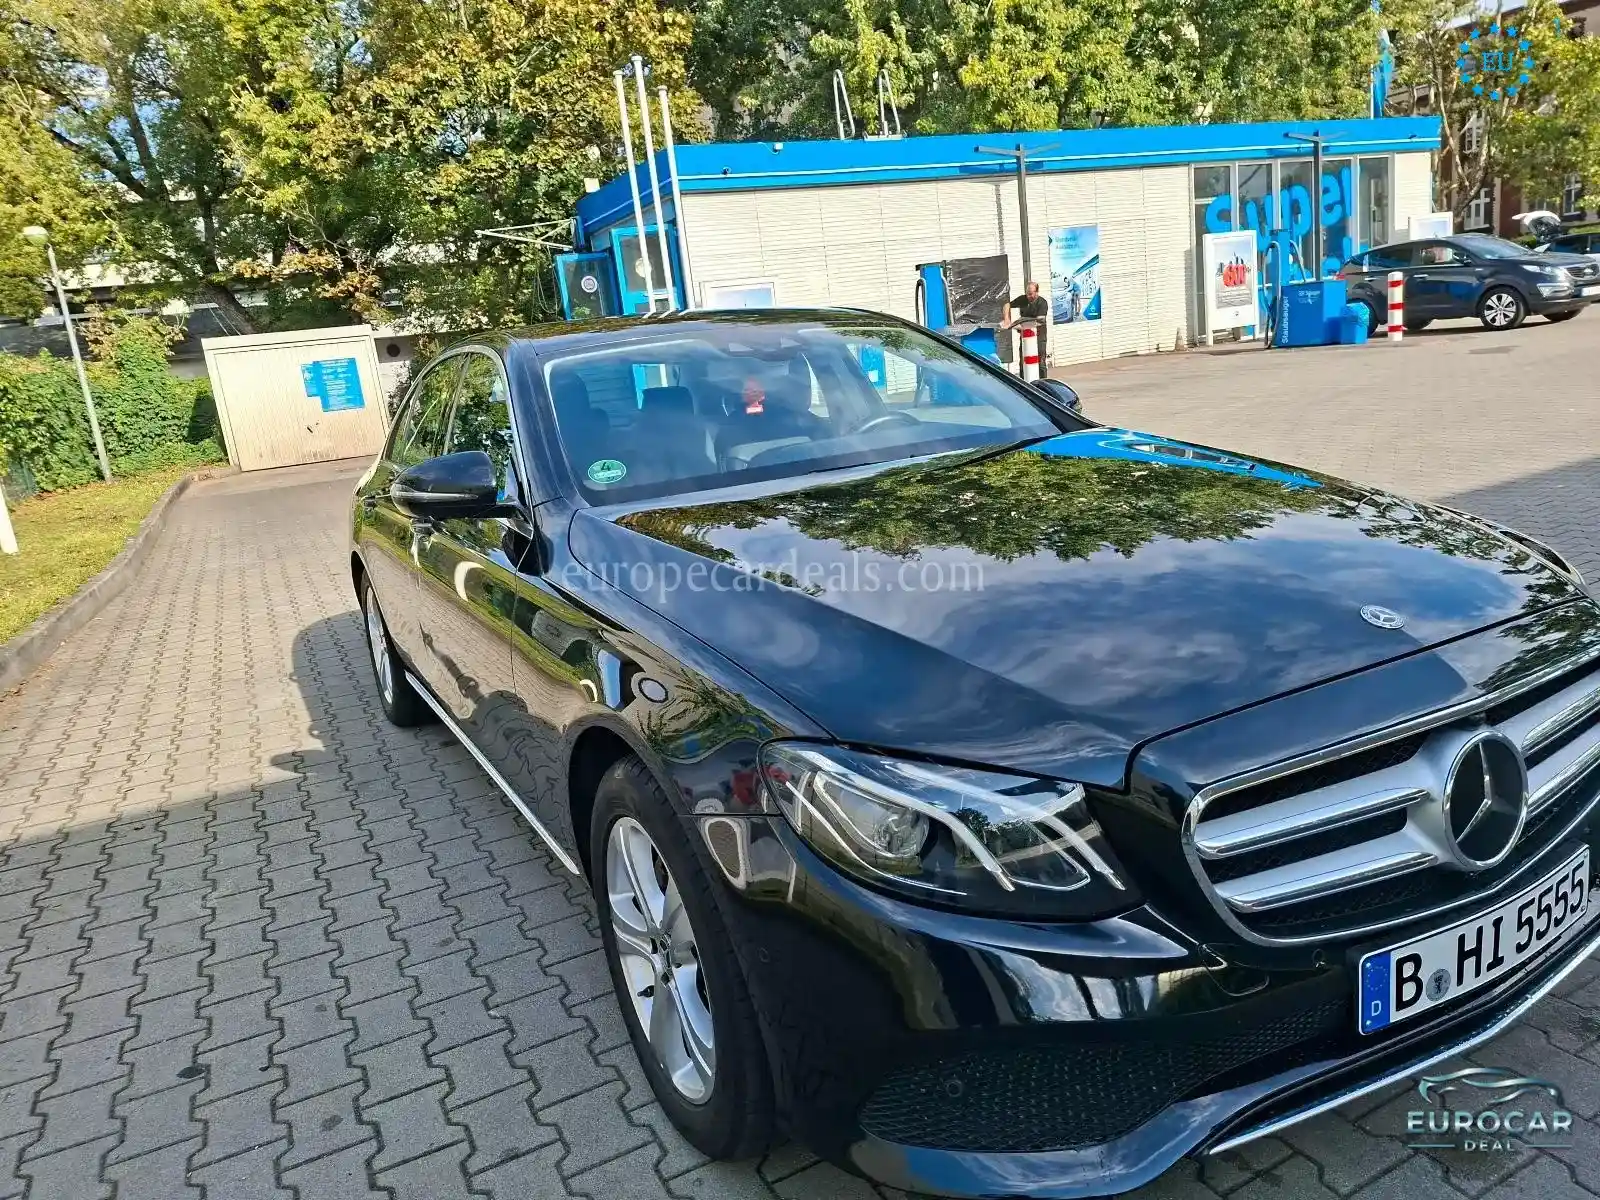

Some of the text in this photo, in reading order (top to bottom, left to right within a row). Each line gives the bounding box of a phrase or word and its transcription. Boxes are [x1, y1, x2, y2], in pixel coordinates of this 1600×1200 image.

[1395, 859, 1585, 1012] B HI 5555
[1371, 1000, 1382, 1017] D
